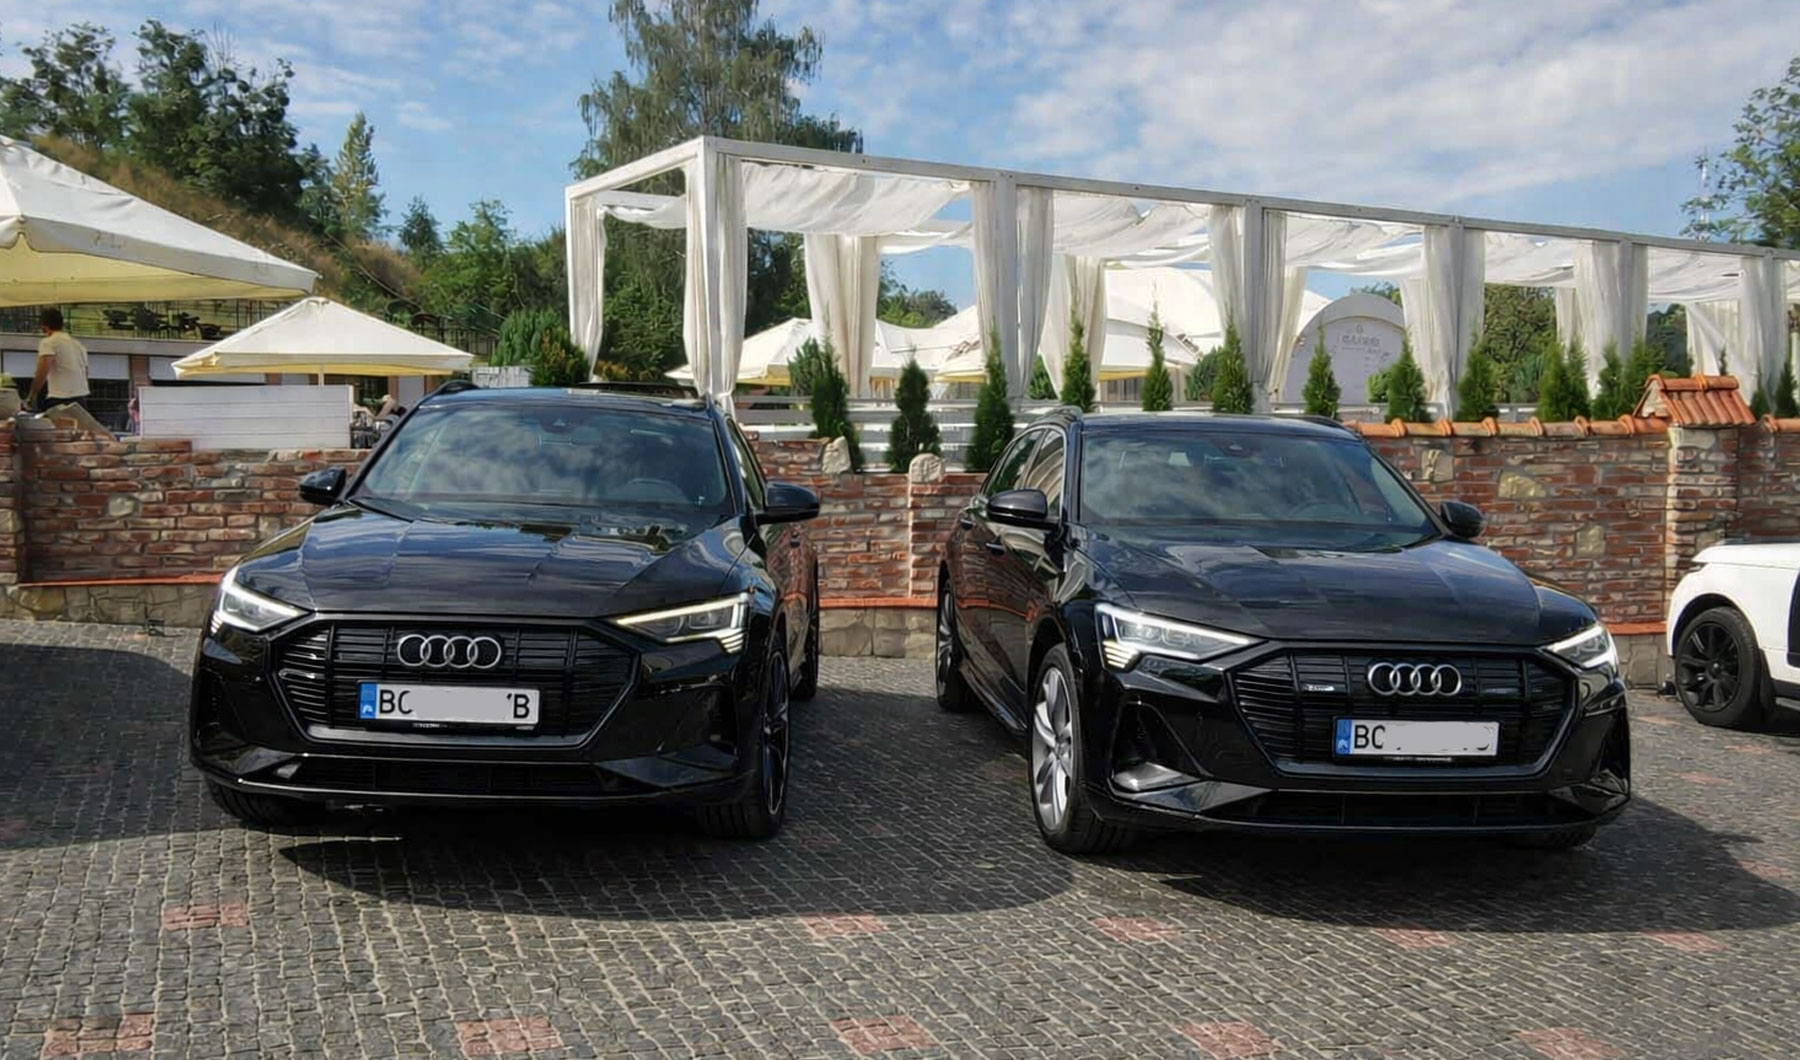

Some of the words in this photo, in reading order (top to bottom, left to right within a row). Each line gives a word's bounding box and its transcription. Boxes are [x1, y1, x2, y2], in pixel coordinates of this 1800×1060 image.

[379, 689, 413, 715] BC
[507, 693, 531, 719] B
[1354, 724, 1386, 749] BC
